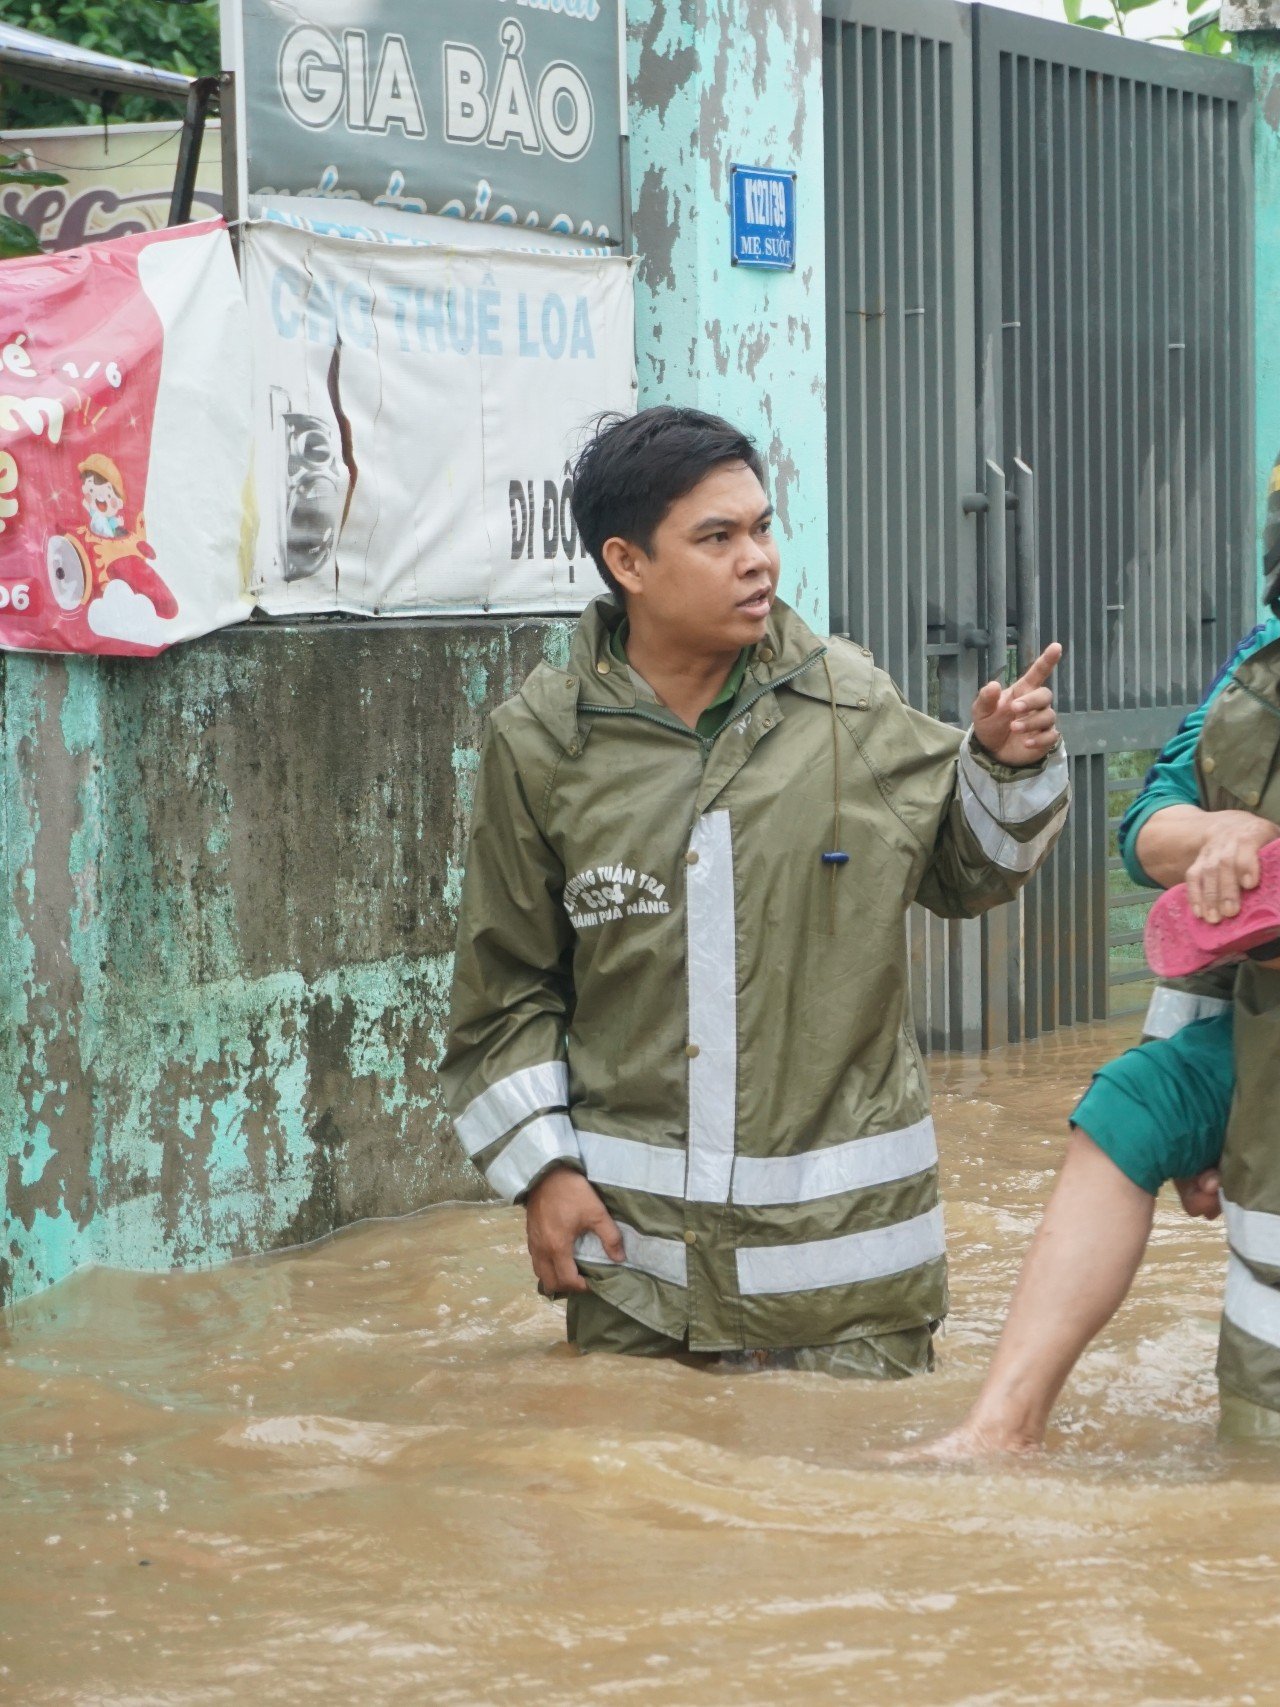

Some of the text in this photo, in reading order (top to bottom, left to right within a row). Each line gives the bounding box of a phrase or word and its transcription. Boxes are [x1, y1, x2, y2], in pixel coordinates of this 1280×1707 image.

[278, 17, 594, 162] GIA BẢO
[385, 273, 503, 357] THUÊ
[518, 290, 596, 360] LOA
[638, 873, 666, 899] TRA
